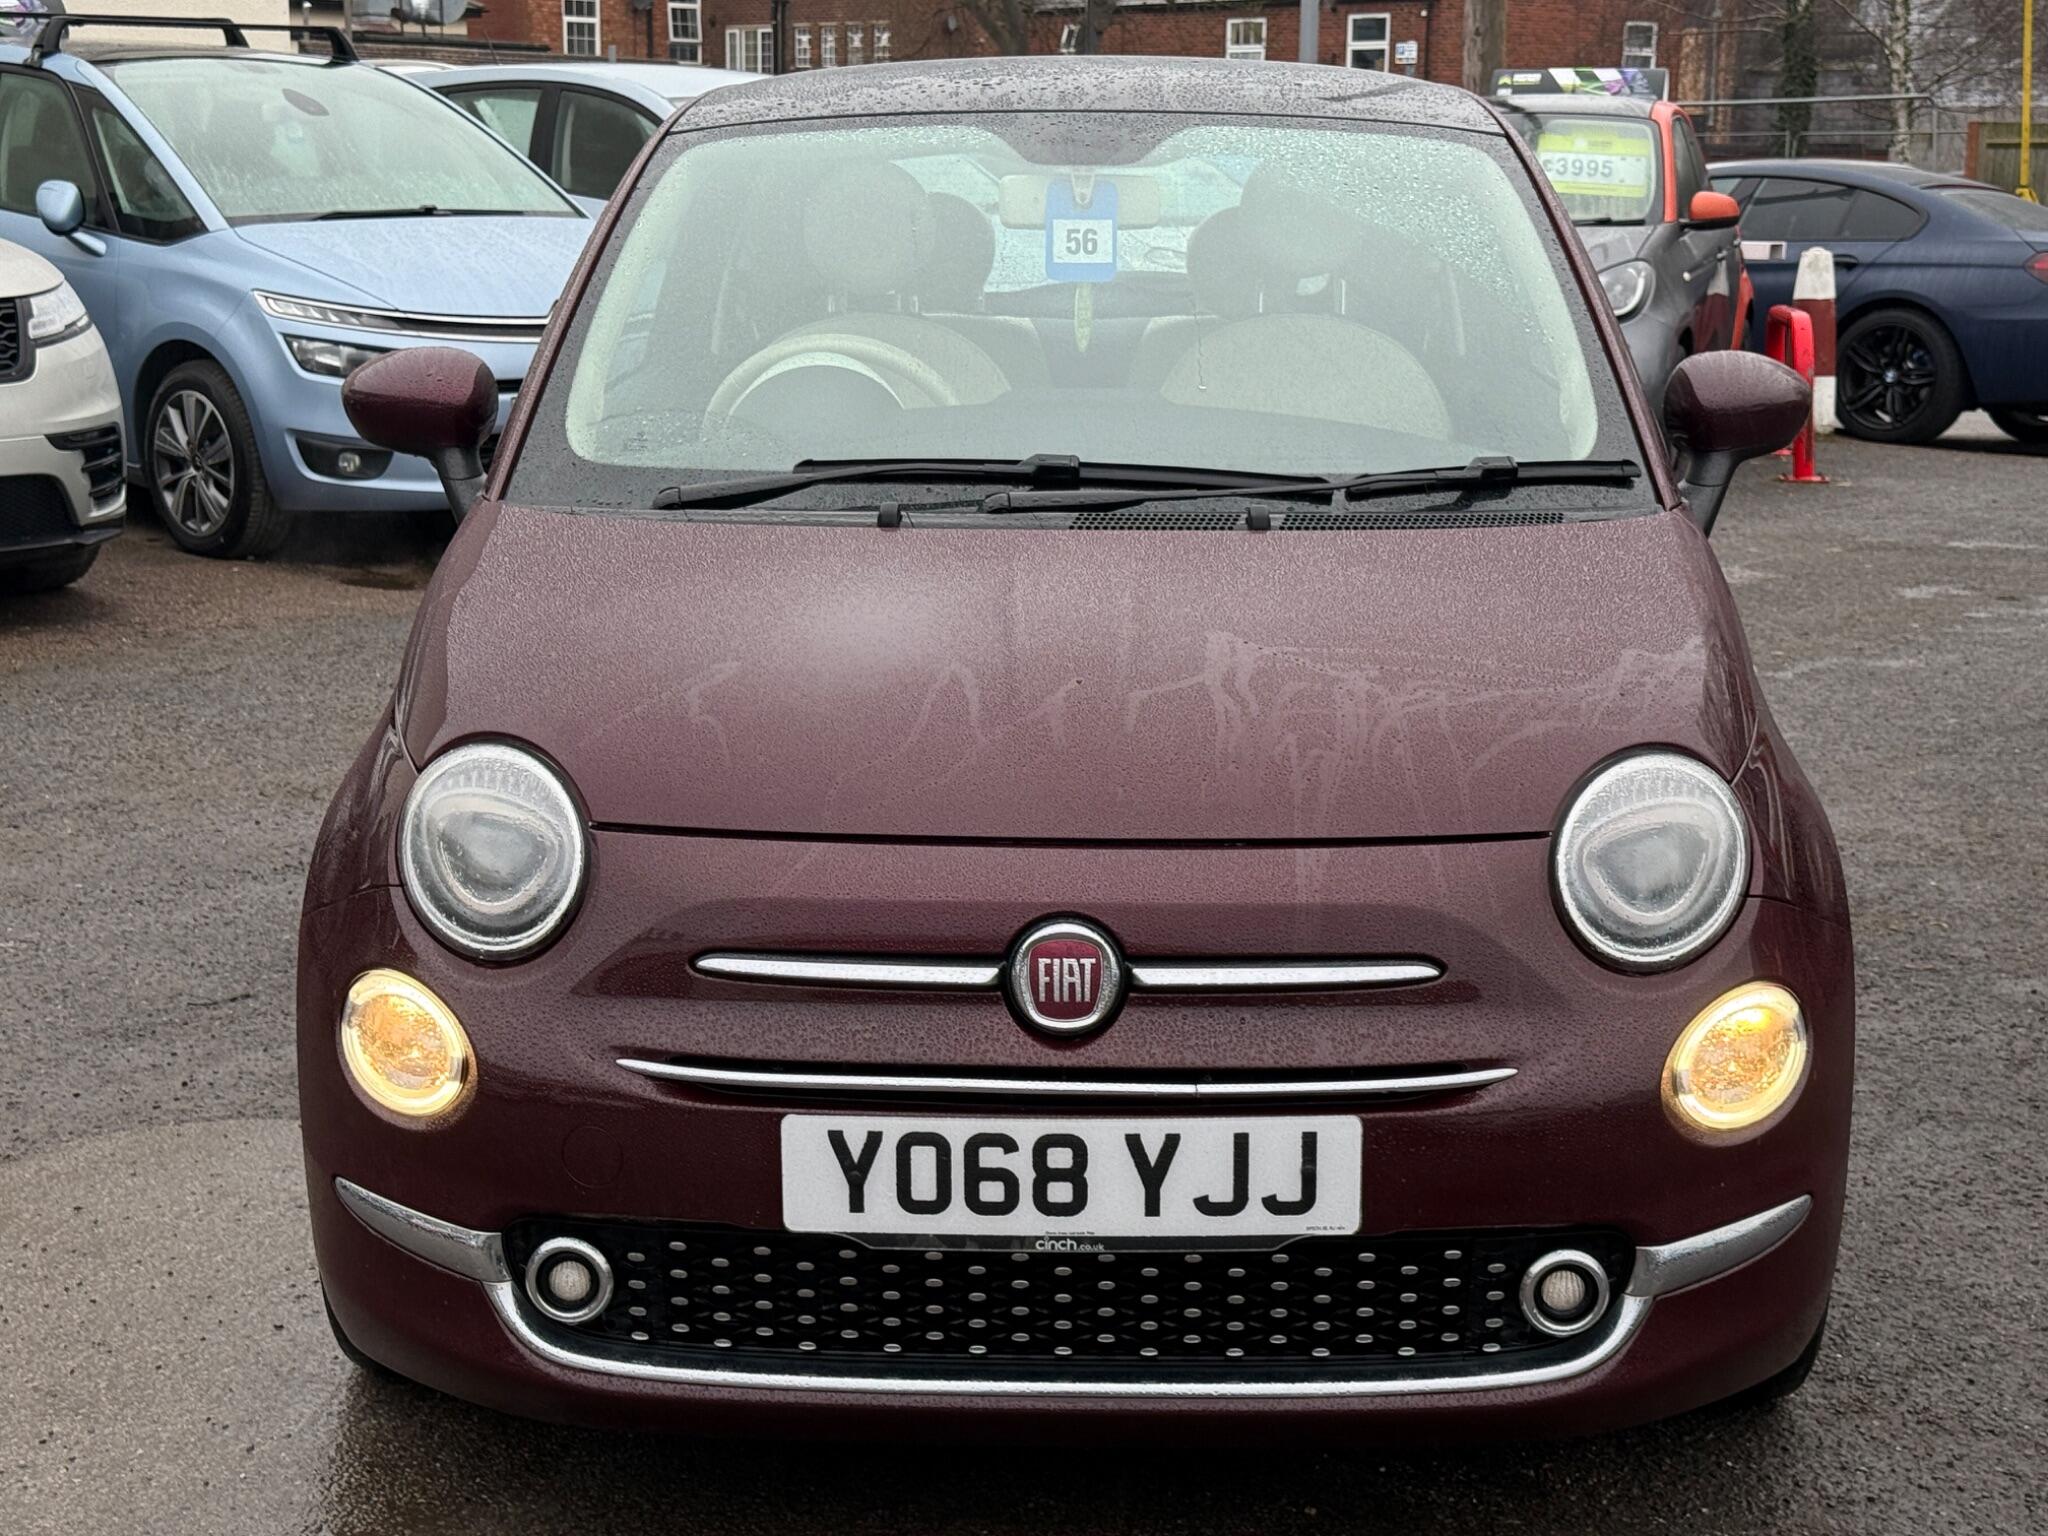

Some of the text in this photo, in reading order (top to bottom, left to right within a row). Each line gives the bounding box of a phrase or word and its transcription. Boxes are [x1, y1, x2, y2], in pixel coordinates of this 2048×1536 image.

[1065, 228, 1098, 255] 56
[1038, 957, 1096, 1003] FIAT
[827, 1130, 1318, 1217] YO68 YJJ
[1035, 1236, 1105, 1252] cinch.co.uk
